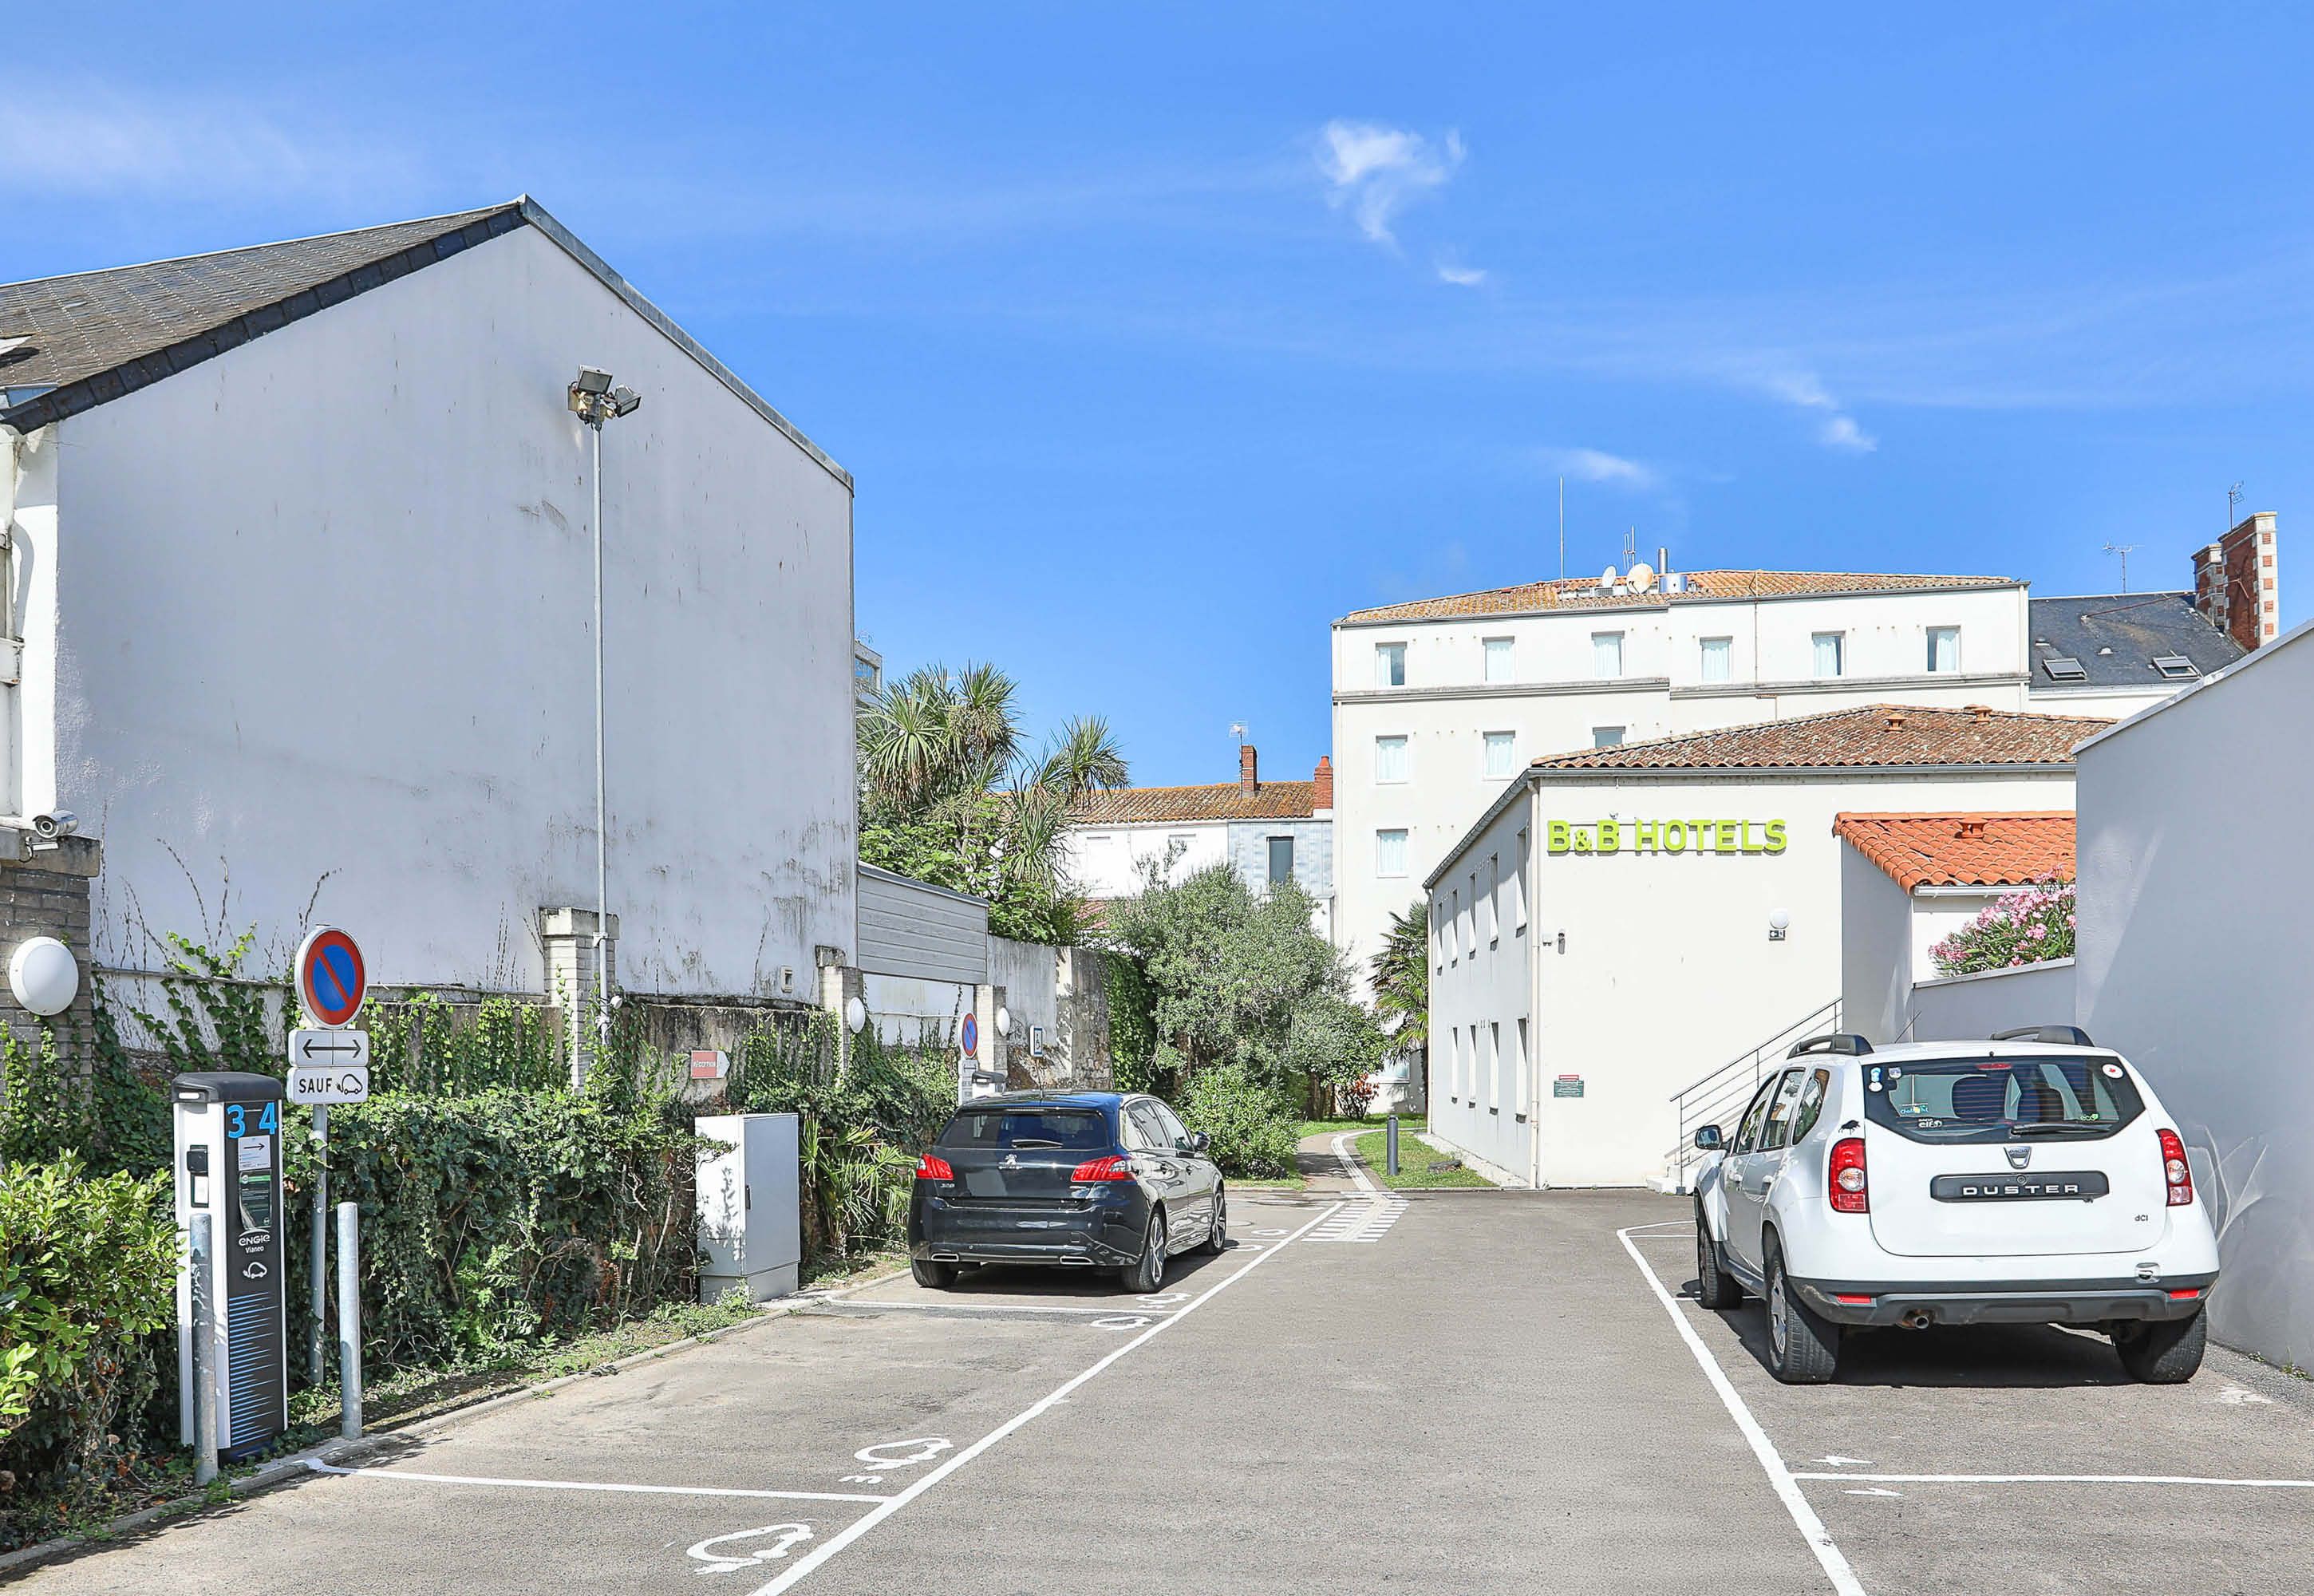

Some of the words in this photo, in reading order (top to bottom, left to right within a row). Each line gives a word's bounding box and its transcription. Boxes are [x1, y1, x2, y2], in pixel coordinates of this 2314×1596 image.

[1548, 820, 1620, 851] B&B
[1635, 819, 1787, 851] HOTELS
[299, 1078, 333, 1093] SAUF
[227, 1104, 246, 1139] 3
[259, 1102, 277, 1135] 4
[1963, 1184, 2079, 1195] DUSTER
